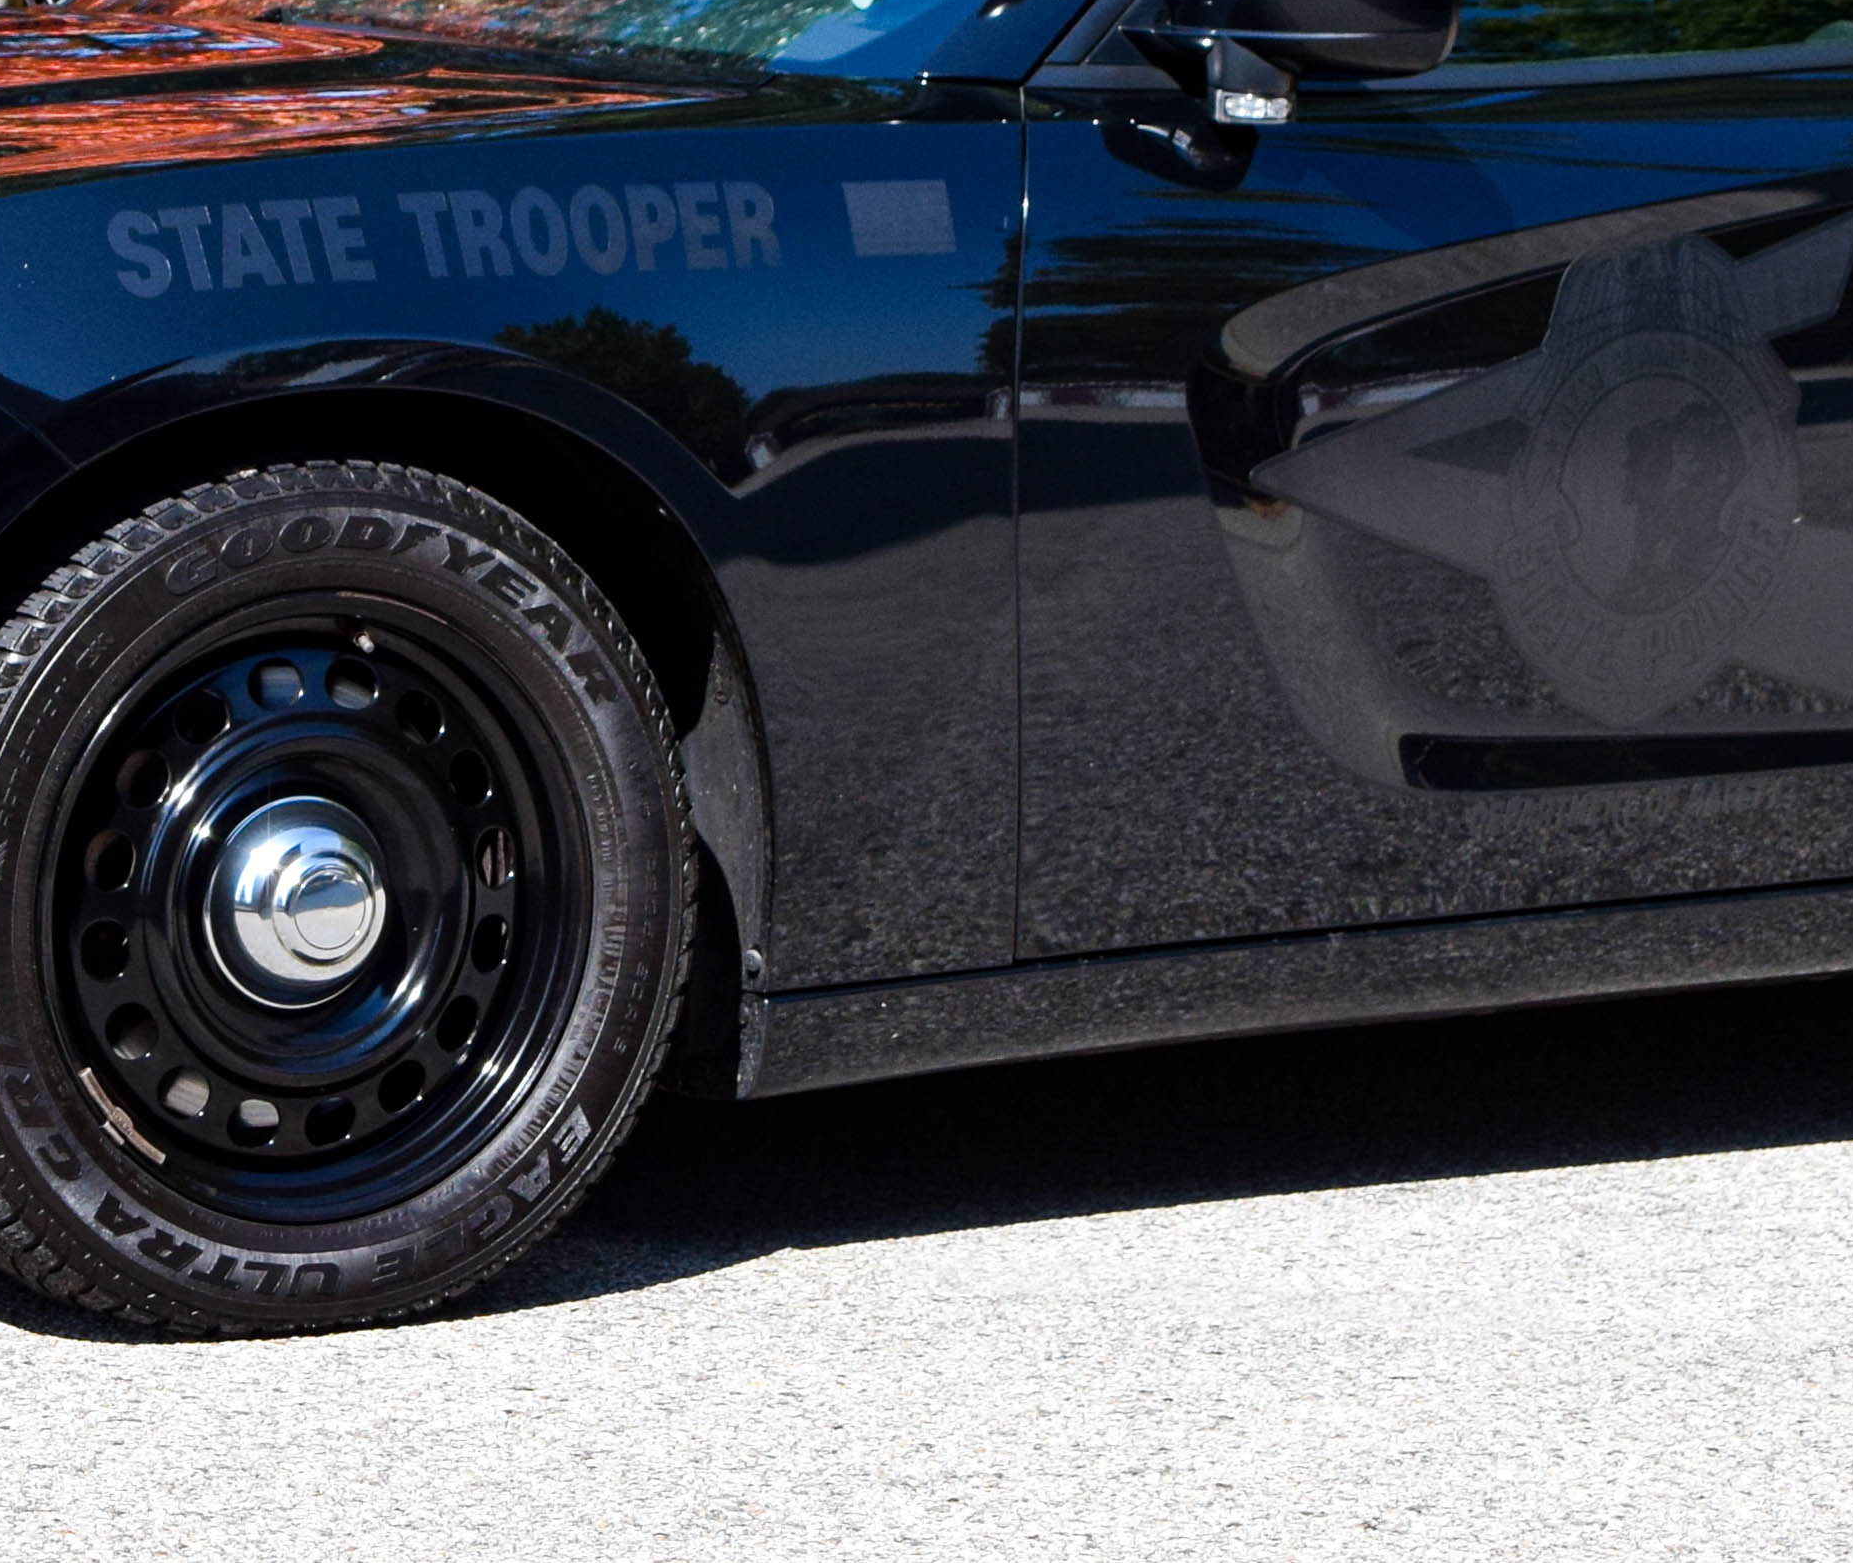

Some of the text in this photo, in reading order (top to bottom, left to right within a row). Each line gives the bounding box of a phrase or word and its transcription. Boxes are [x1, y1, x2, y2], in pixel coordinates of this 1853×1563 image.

[106, 180, 782, 298] STATE TROOPER
[165, 514, 622, 707] GOODYEAR
[95, 1189, 341, 1296] ULTRA
[370, 1103, 593, 1285] EAGLE
